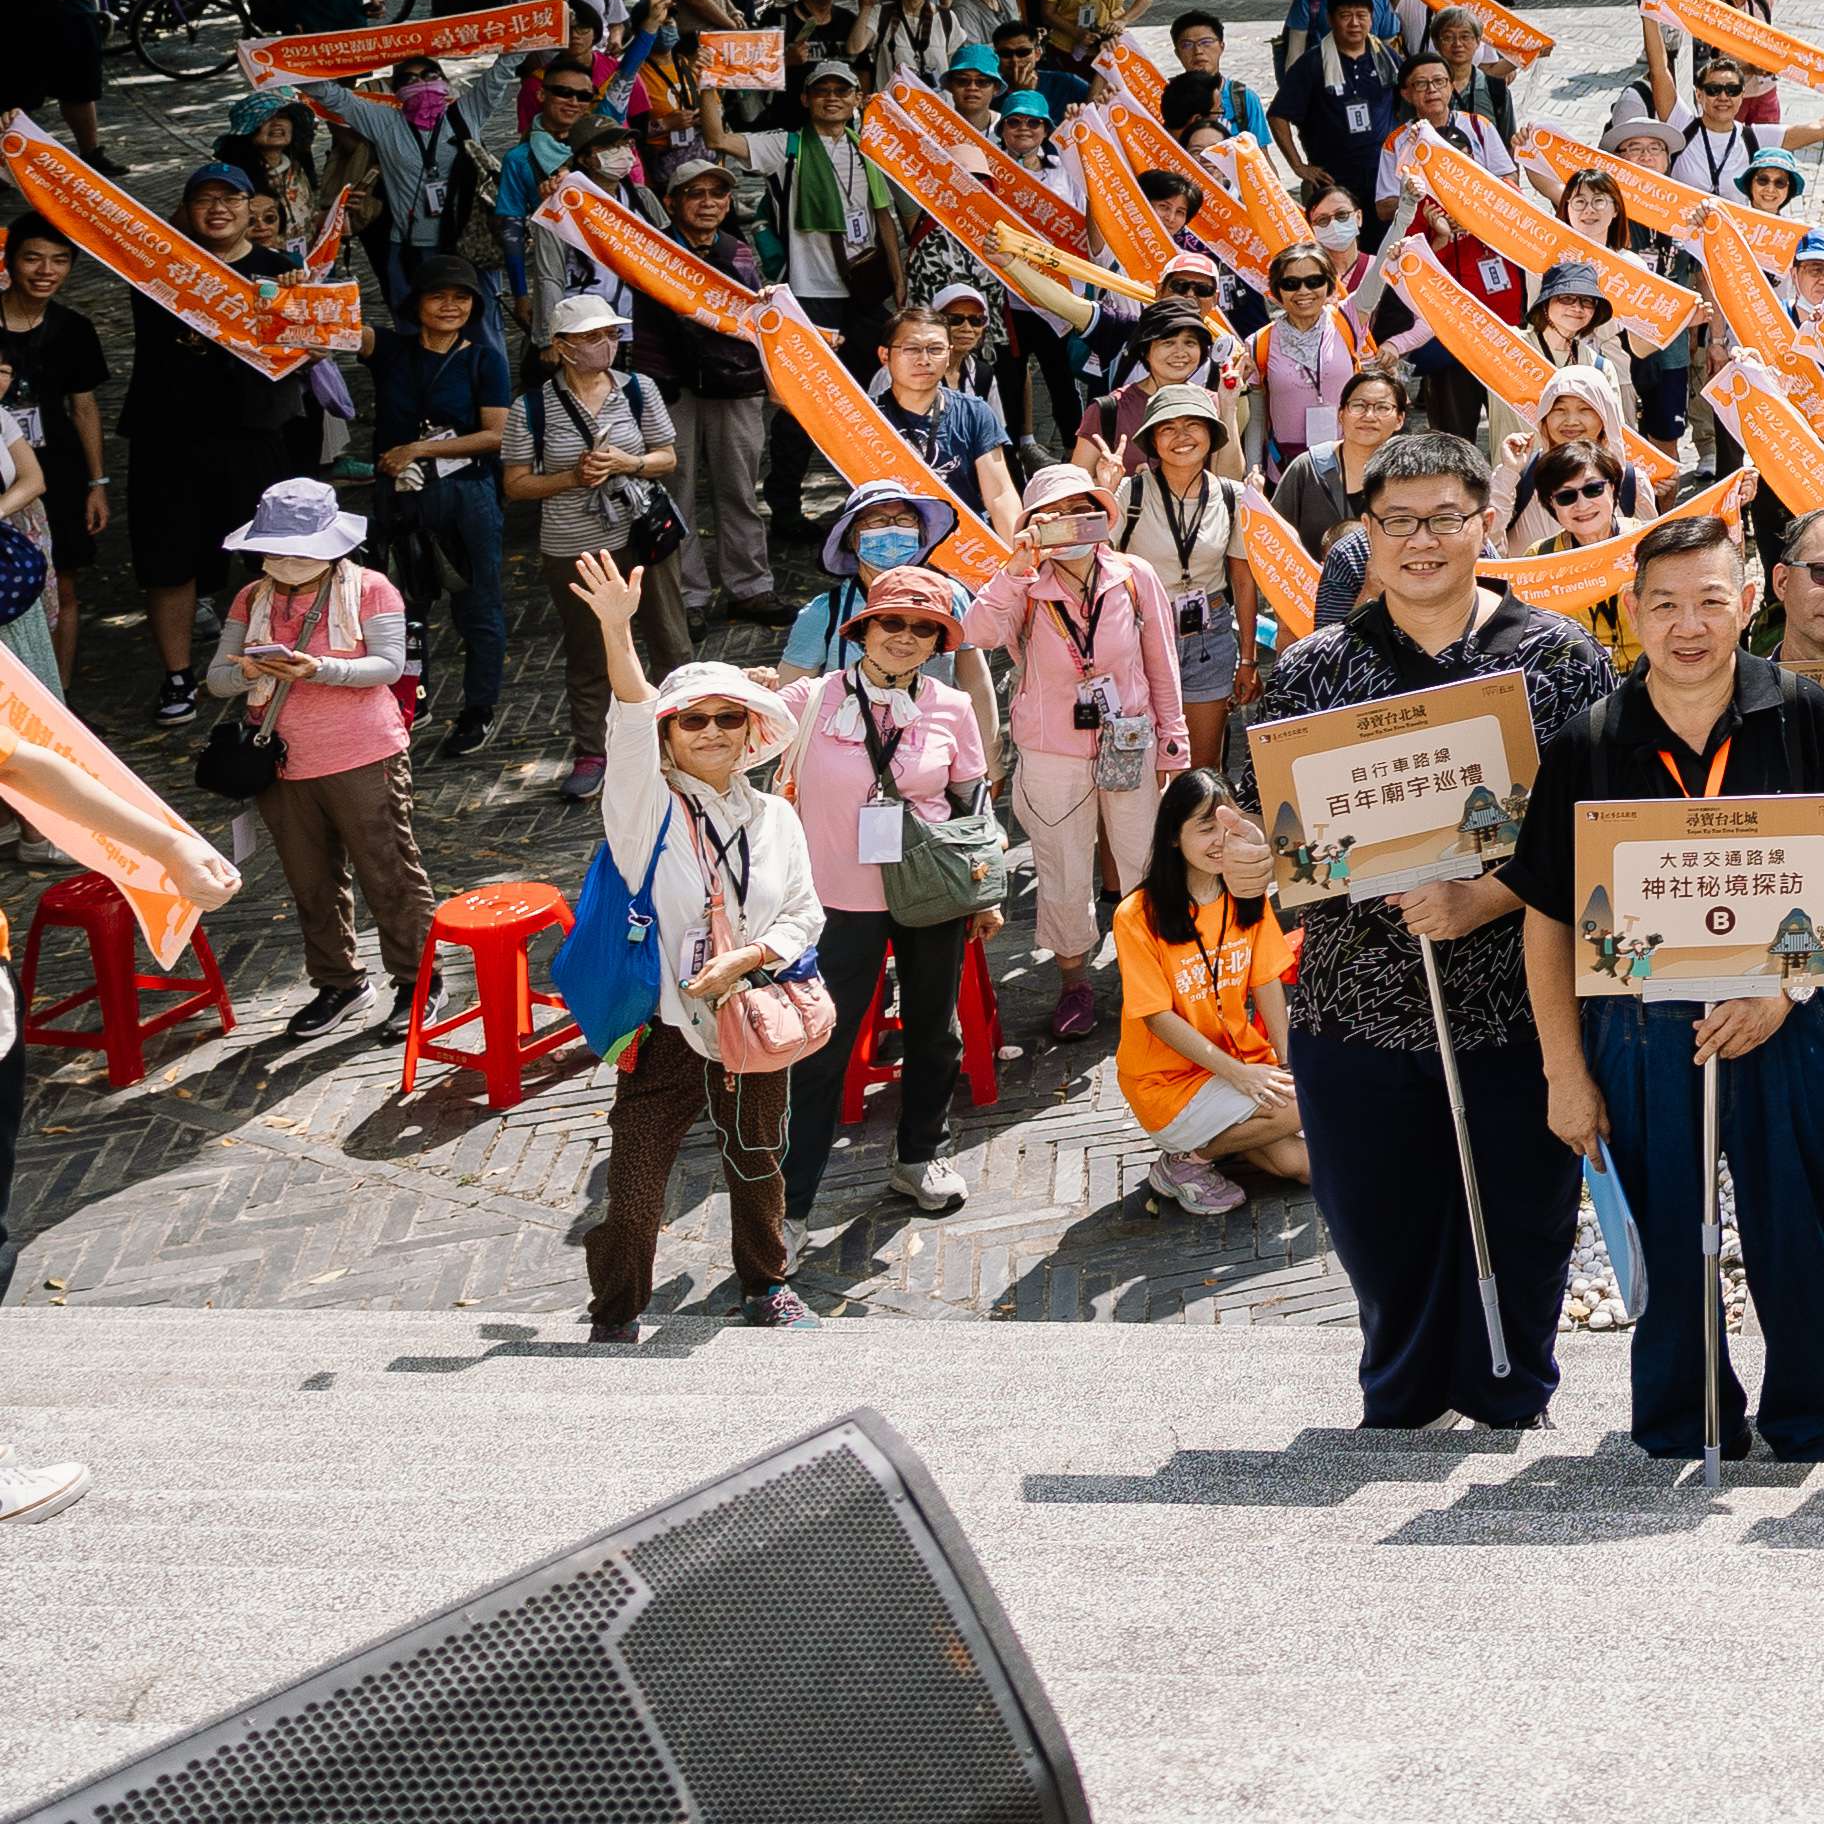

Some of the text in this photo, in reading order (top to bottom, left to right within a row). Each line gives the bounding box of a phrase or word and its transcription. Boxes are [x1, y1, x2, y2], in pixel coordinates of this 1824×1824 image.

[431, 7, 554, 49] 尋寶台北城
[166, 256, 256, 336] 尋寶台
[1357, 705, 1427, 731] 尋寶台北城
[1352, 747, 1451, 783] 自行車路線
[1326, 764, 1484, 818] 百年廟宇巡禮
[1686, 809, 1758, 827] 尋寶台北城
[1660, 848, 1785, 869] 大眾交通路線
[1641, 873, 1803, 900] 神社秘境探訪
[1713, 912, 1729, 929] B
